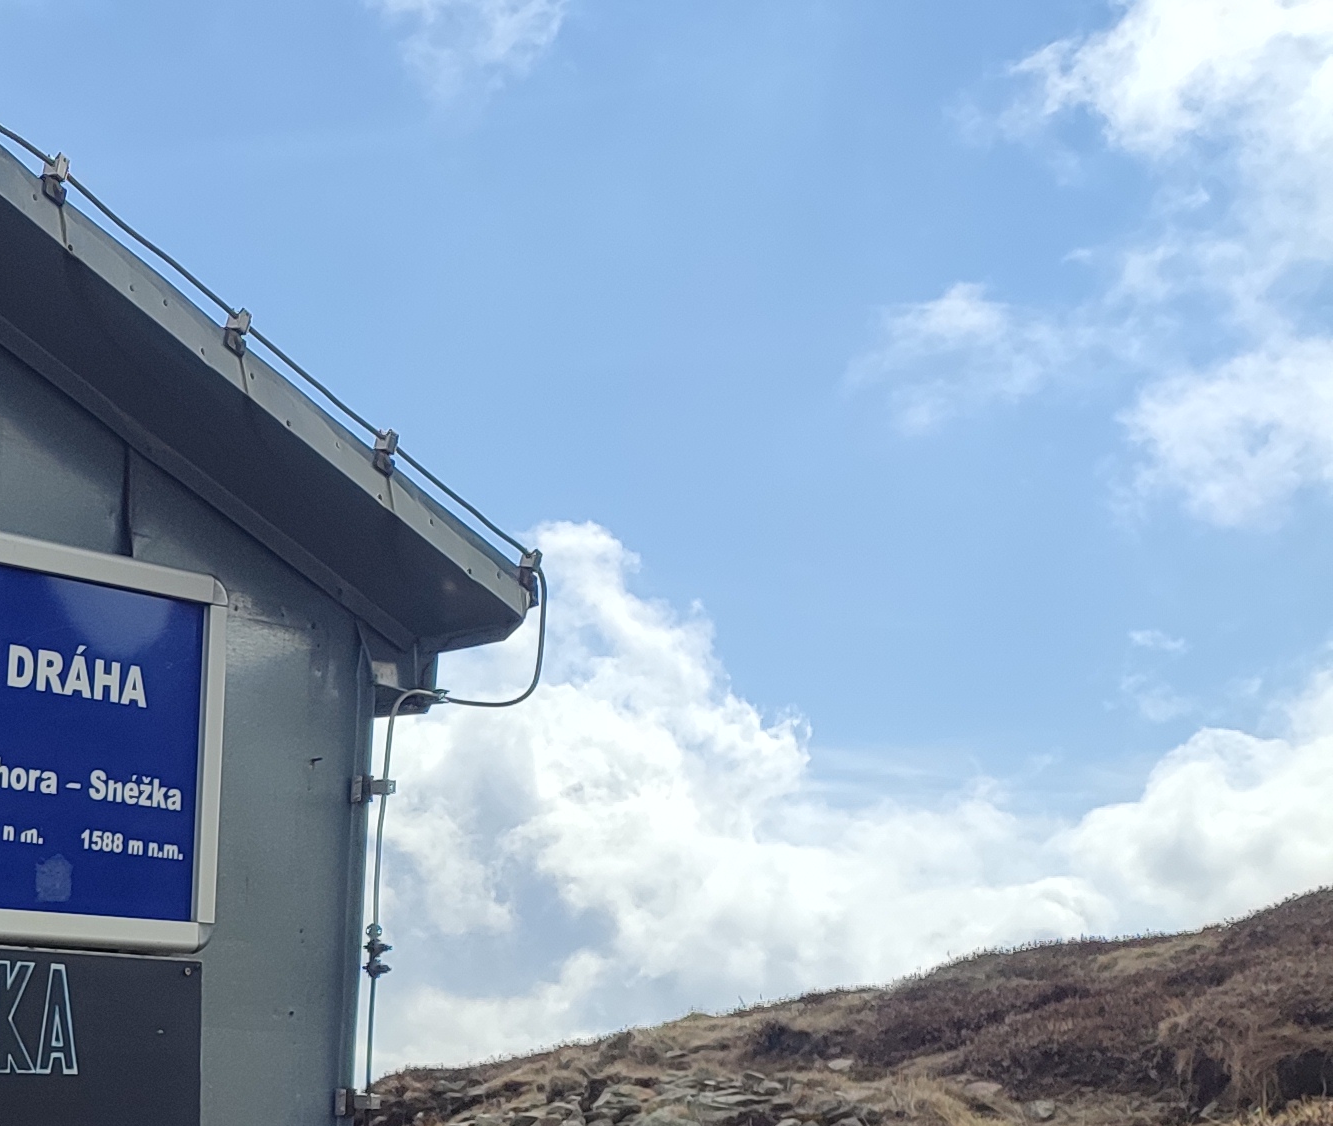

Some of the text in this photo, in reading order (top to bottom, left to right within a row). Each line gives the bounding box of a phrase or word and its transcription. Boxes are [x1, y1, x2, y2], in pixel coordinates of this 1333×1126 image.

[7, 645, 147, 708] DRÁHA
[81, 828, 184, 861] 1588 m n.m.
